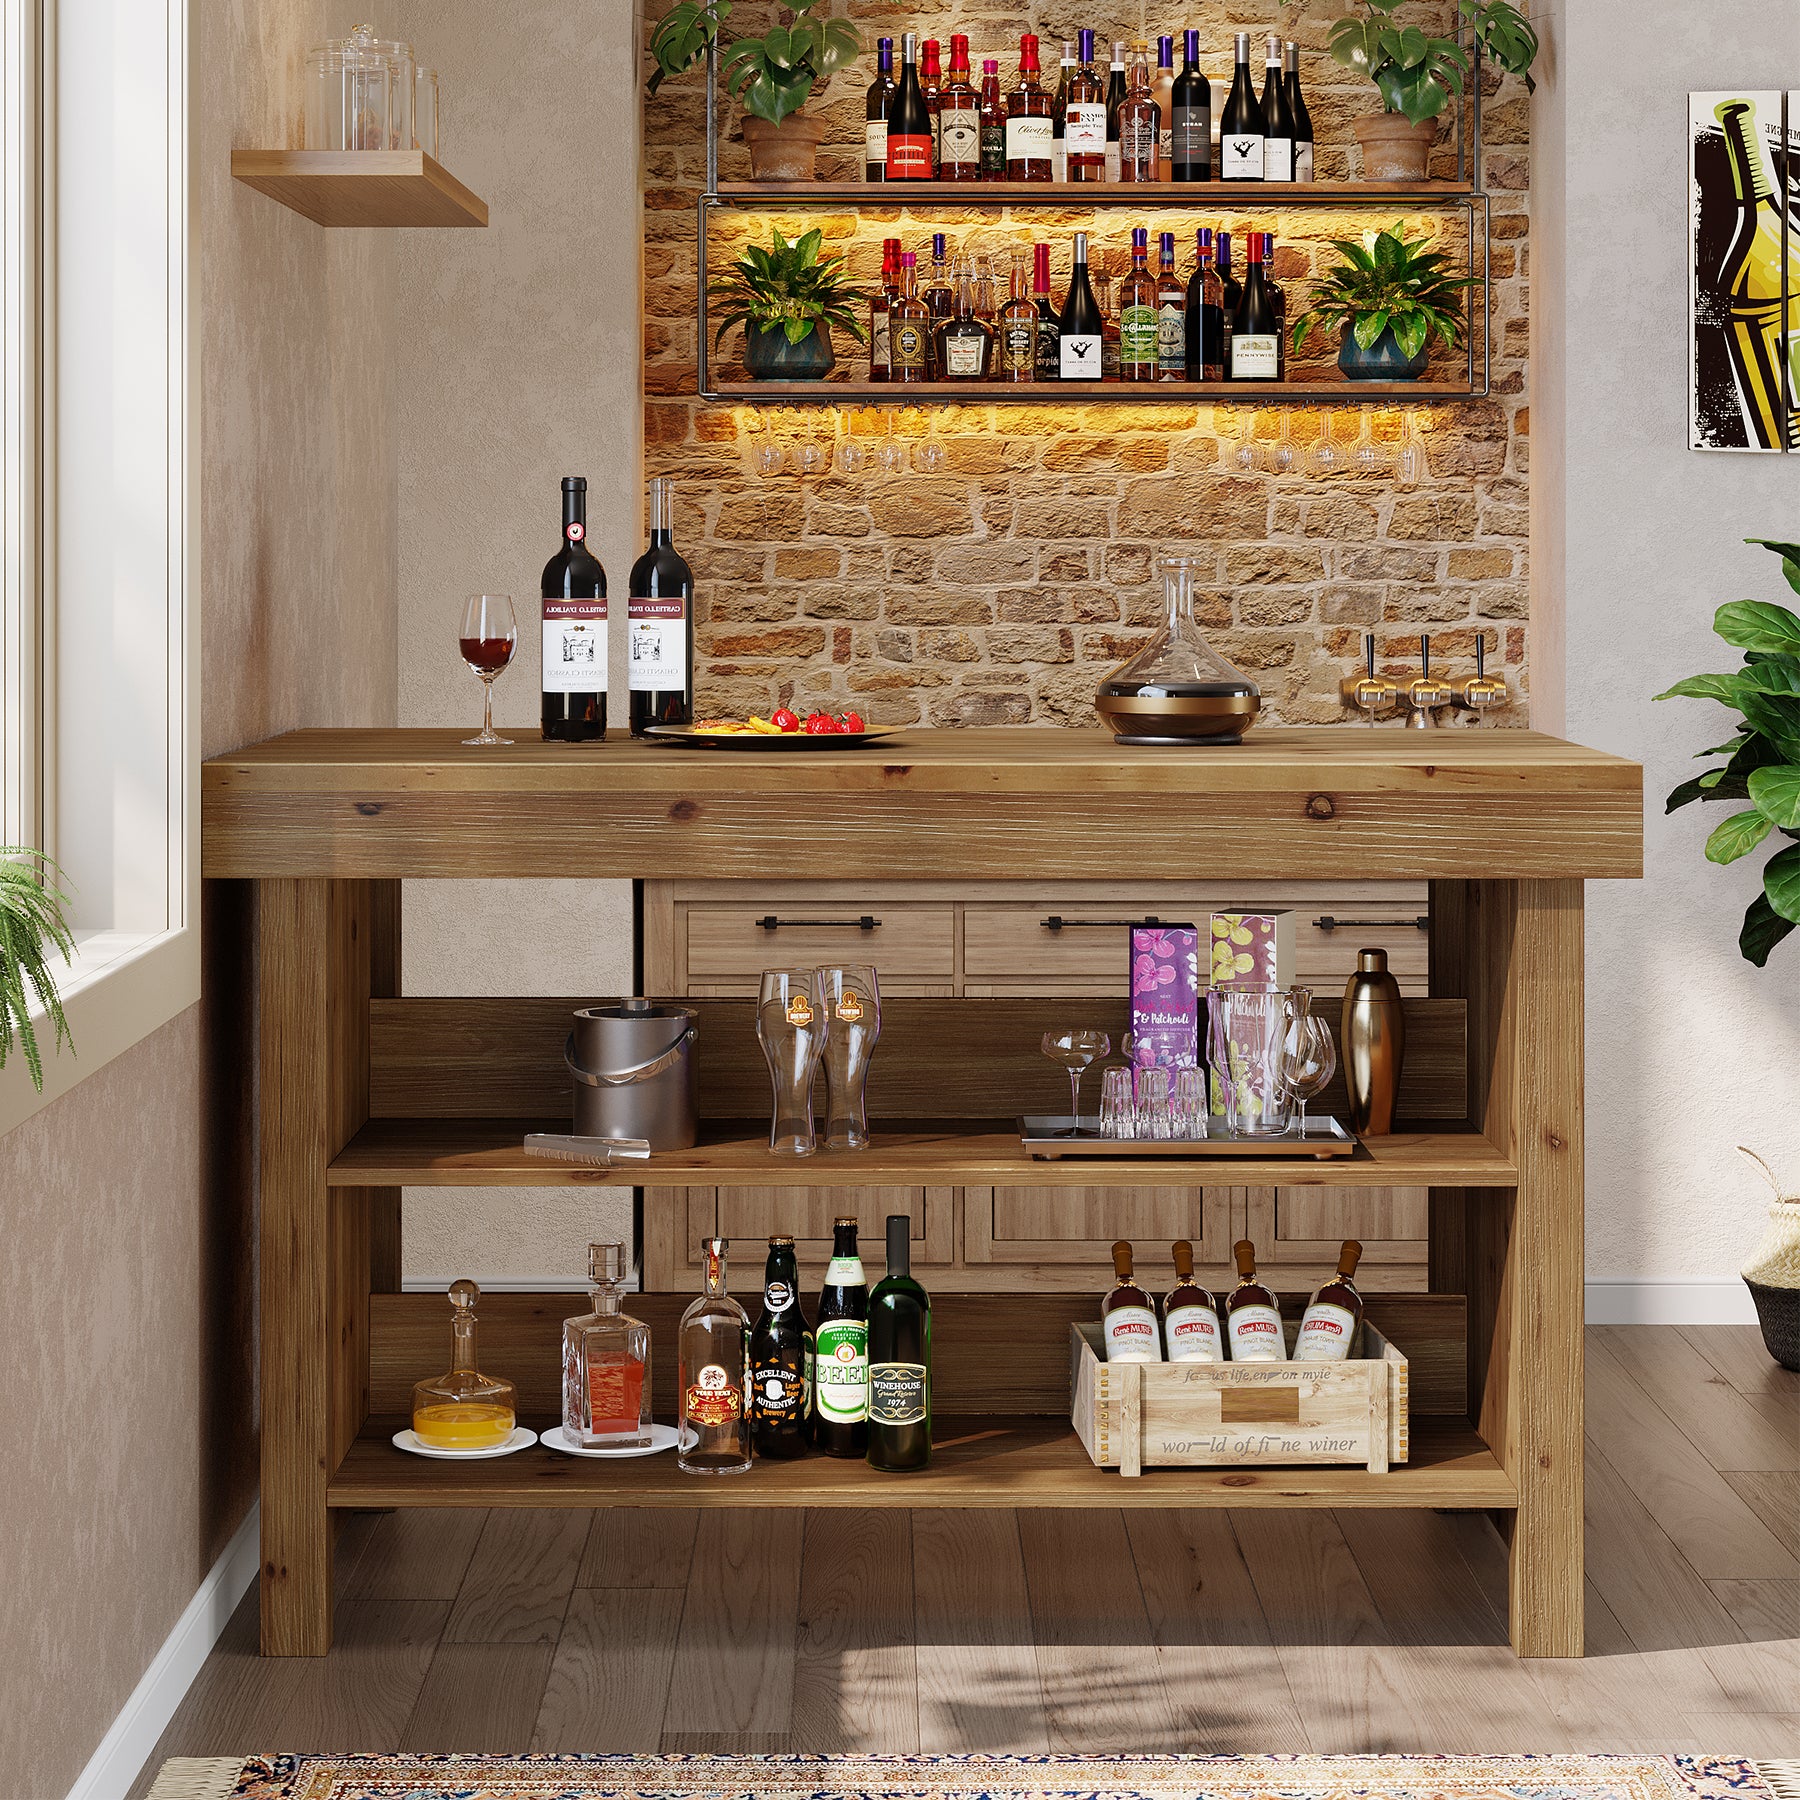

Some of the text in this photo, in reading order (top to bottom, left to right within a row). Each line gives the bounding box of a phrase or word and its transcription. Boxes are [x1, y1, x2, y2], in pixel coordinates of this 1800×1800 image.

[1140, 1012, 1190, 1025] & Patchouli
[755, 1369, 797, 1382] EXCELLENT
[784, 1382, 801, 1390] Lager
[873, 1380, 922, 1390] WINEHOUSE
[756, 1396, 797, 1409] AUTHENTIC
[887, 1399, 906, 1407] 1974
[762, 1408, 787, 1418] Brewery
[1233, 1435, 1255, 1457] of
[1308, 1436, 1357, 1452] winer
